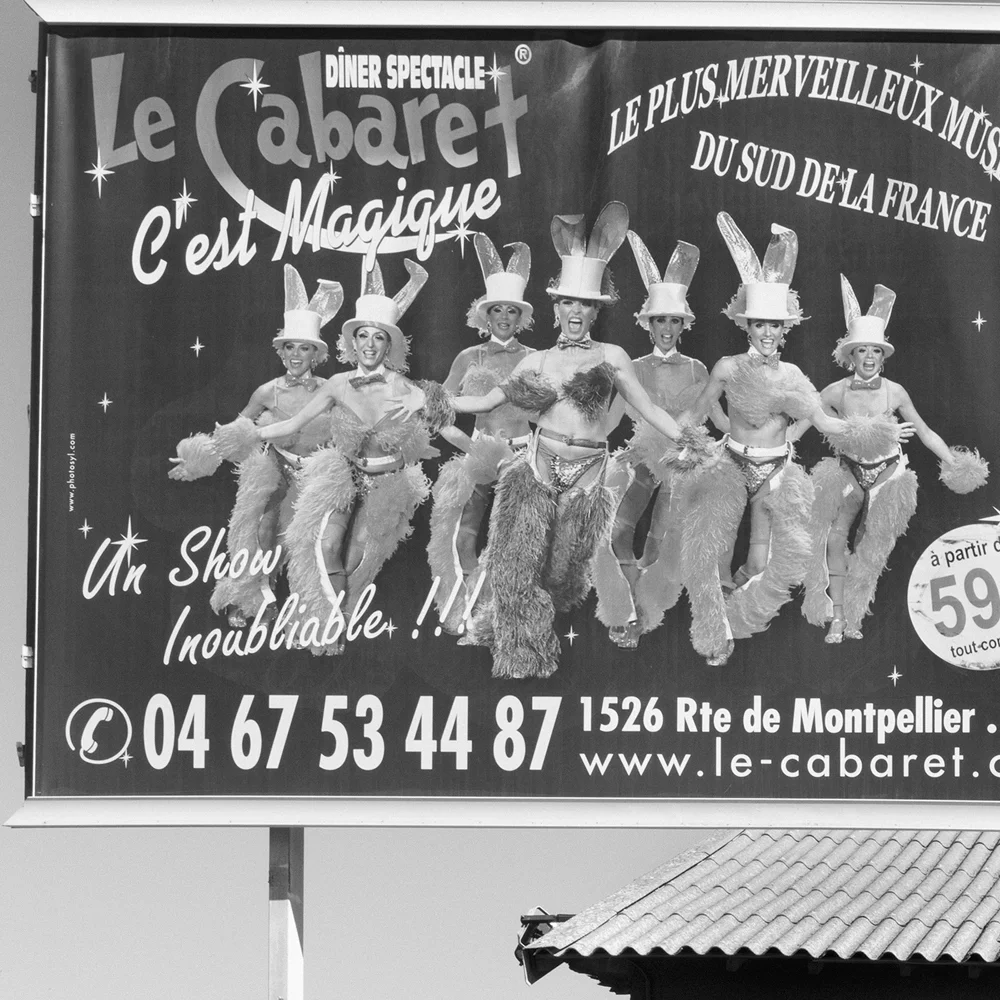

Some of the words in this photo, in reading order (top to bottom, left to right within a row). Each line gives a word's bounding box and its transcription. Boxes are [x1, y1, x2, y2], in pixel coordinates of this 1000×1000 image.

[325, 46, 382, 89] DÎNER
[386, 54, 486, 90] SPECTACLE
[606, 95, 643, 156] LE
[644, 63, 720, 132] PLUS
[721, 55, 945, 133] MERVEILLEUX
[90, 52, 177, 169] Le
[196, 50, 528, 255] Cabaret
[690, 129, 739, 176] DU
[736, 142, 796, 192] SUD
[796, 157, 840, 205] DE
[838, 167, 875, 214] LA
[878, 177, 992, 243] FRANCE
[131, 187, 258, 286] C'est
[271, 172, 503, 272] Magique
[66, 432, 78, 513] www.photosyl.com
[81, 537, 147, 600] Un
[168, 525, 284, 587] Show
[929, 548, 942, 568] à
[943, 541, 989, 568] partir
[162, 583, 389, 666] Inoubliable
[142, 692, 210, 771] 04
[230, 693, 299, 771] 67
[318, 694, 386, 771] 53
[404, 695, 473, 771] 44
[492, 695, 563, 771] 87
[579, 695, 664, 733] 1526
[676, 696, 732, 733] Rte
[742, 694, 781, 733] de
[791, 695, 976, 745] Montpellier
